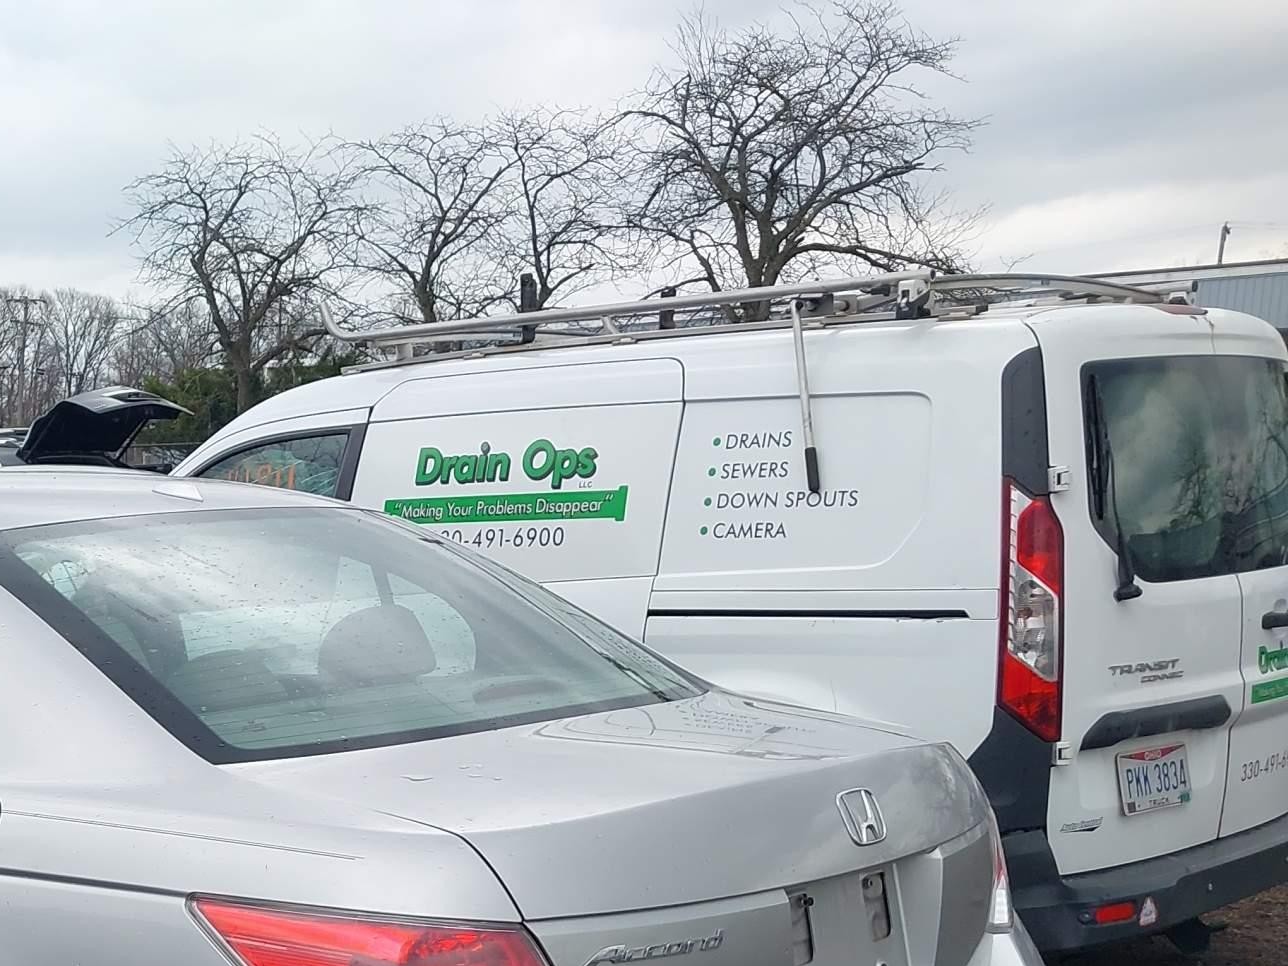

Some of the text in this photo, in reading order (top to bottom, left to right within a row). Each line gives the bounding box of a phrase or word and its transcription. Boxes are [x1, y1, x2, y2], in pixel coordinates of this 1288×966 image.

[725, 431, 792, 449] DRAINS
[415, 439, 598, 489] Drain Ops
[720, 461, 789, 479] SEWERS
[578, 480, 593, 489] LLC
[447, 502, 472, 517] Your
[476, 499, 532, 515] Problems
[716, 490, 859, 509] DOWN SPOUTS
[713, 521, 787, 539] CAMERA
[1108, 657, 1180, 676] TRANSIT
[1154, 758, 1187, 793] 3834
